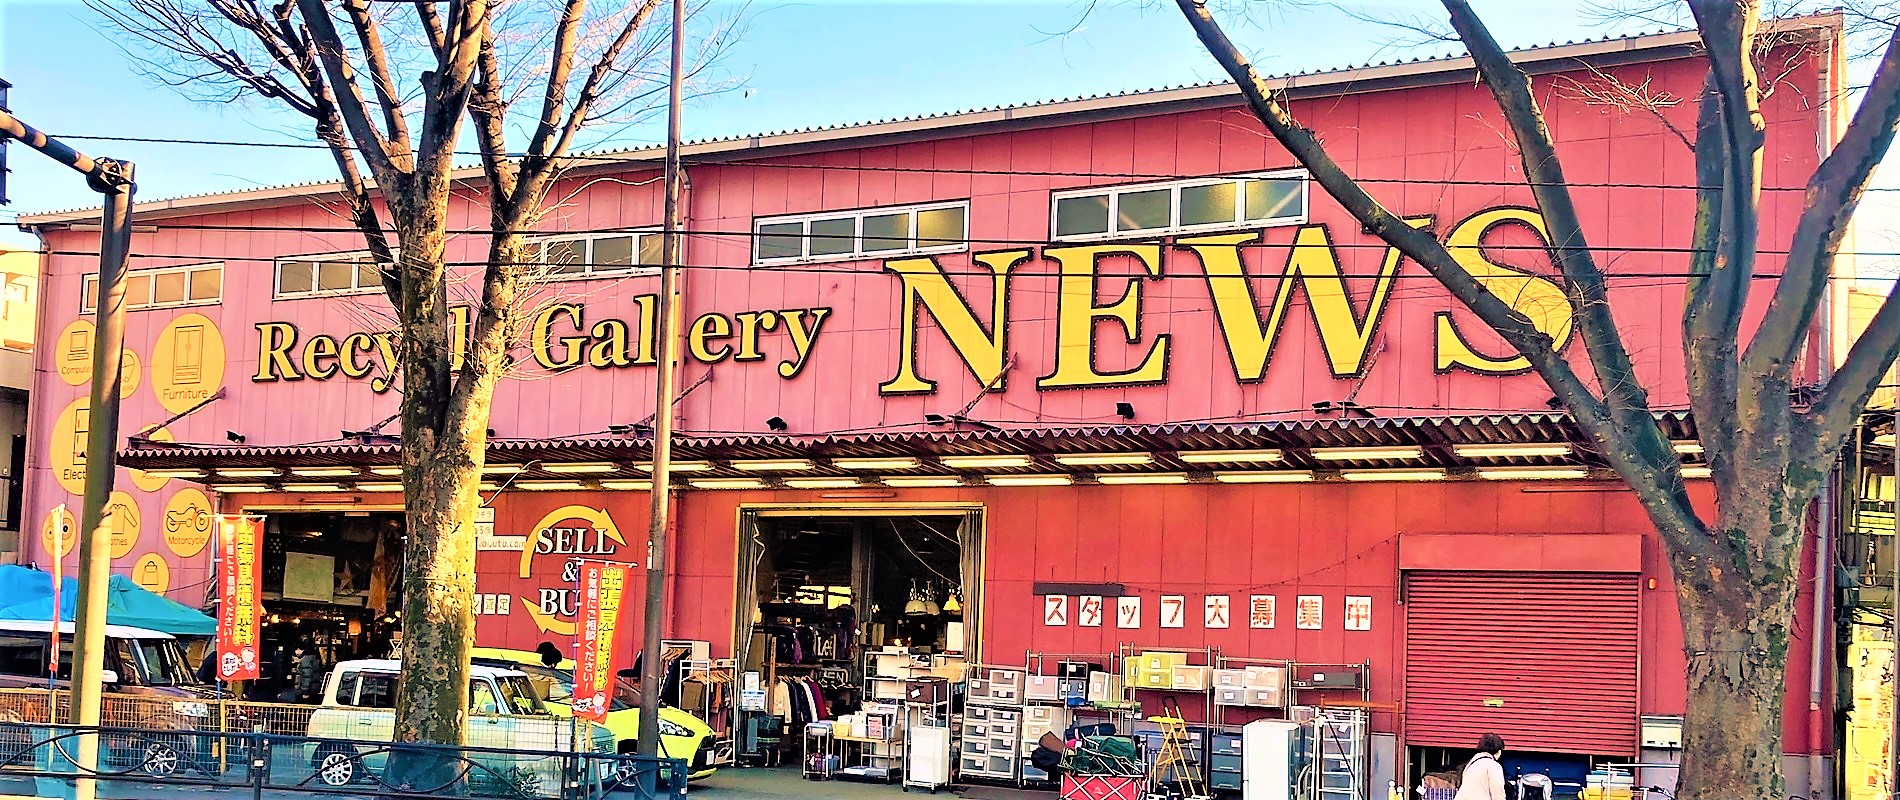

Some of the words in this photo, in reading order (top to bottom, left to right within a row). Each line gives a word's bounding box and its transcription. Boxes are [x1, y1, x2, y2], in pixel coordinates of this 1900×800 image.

[251, 304, 472, 394] Recyl
[879, 206, 1577, 396] NEWS
[163, 388, 208, 400] Furniture
[110, 537, 128, 546] othes
[168, 536, 206, 546] Motorcycle
[534, 527, 616, 554] SELL
[561, 562, 579, 581] &
[538, 588, 581, 616] BU
[1046, 596, 1369, 628] スタッフ大募集中
